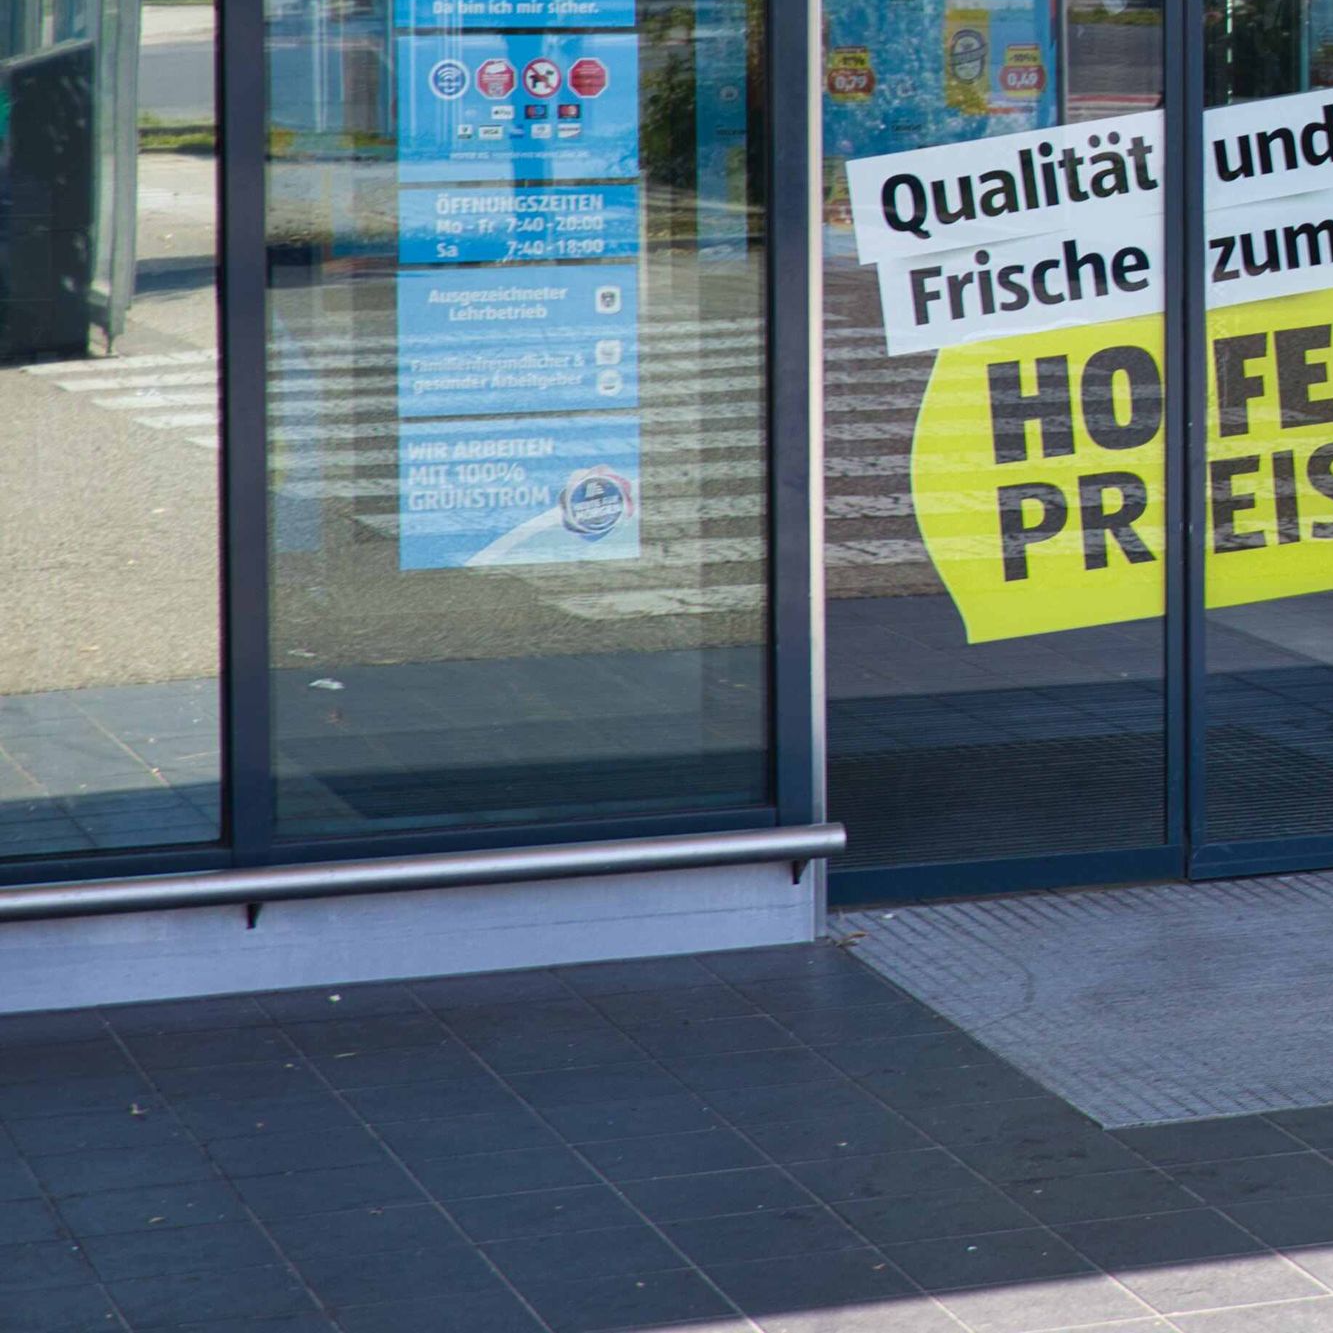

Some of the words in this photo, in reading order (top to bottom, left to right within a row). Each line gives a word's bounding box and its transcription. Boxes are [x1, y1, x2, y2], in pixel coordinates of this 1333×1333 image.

[432, 0, 452, 15] Da
[458, 0, 484, 14] bin
[488, 0, 513, 14] ich
[516, 0, 544, 14] mir
[548, 0, 600, 15] sicher.
[881, 130, 1158, 239] Qualität
[436, 193, 604, 215] ÖFFNUNGSZEITEN
[436, 220, 463, 234] Mo
[436, 243, 459, 258] Sa
[910, 239, 1150, 326] Frische
[428, 287, 569, 306] Ausgezeichneter
[449, 304, 548, 322] Lehrbetrieb
[408, 442, 449, 460] WIR
[454, 438, 554, 458] ARBEITEN
[408, 465, 452, 486] MIT
[458, 461, 526, 484] 100%
[408, 483, 550, 510] GRÜNSTROM
